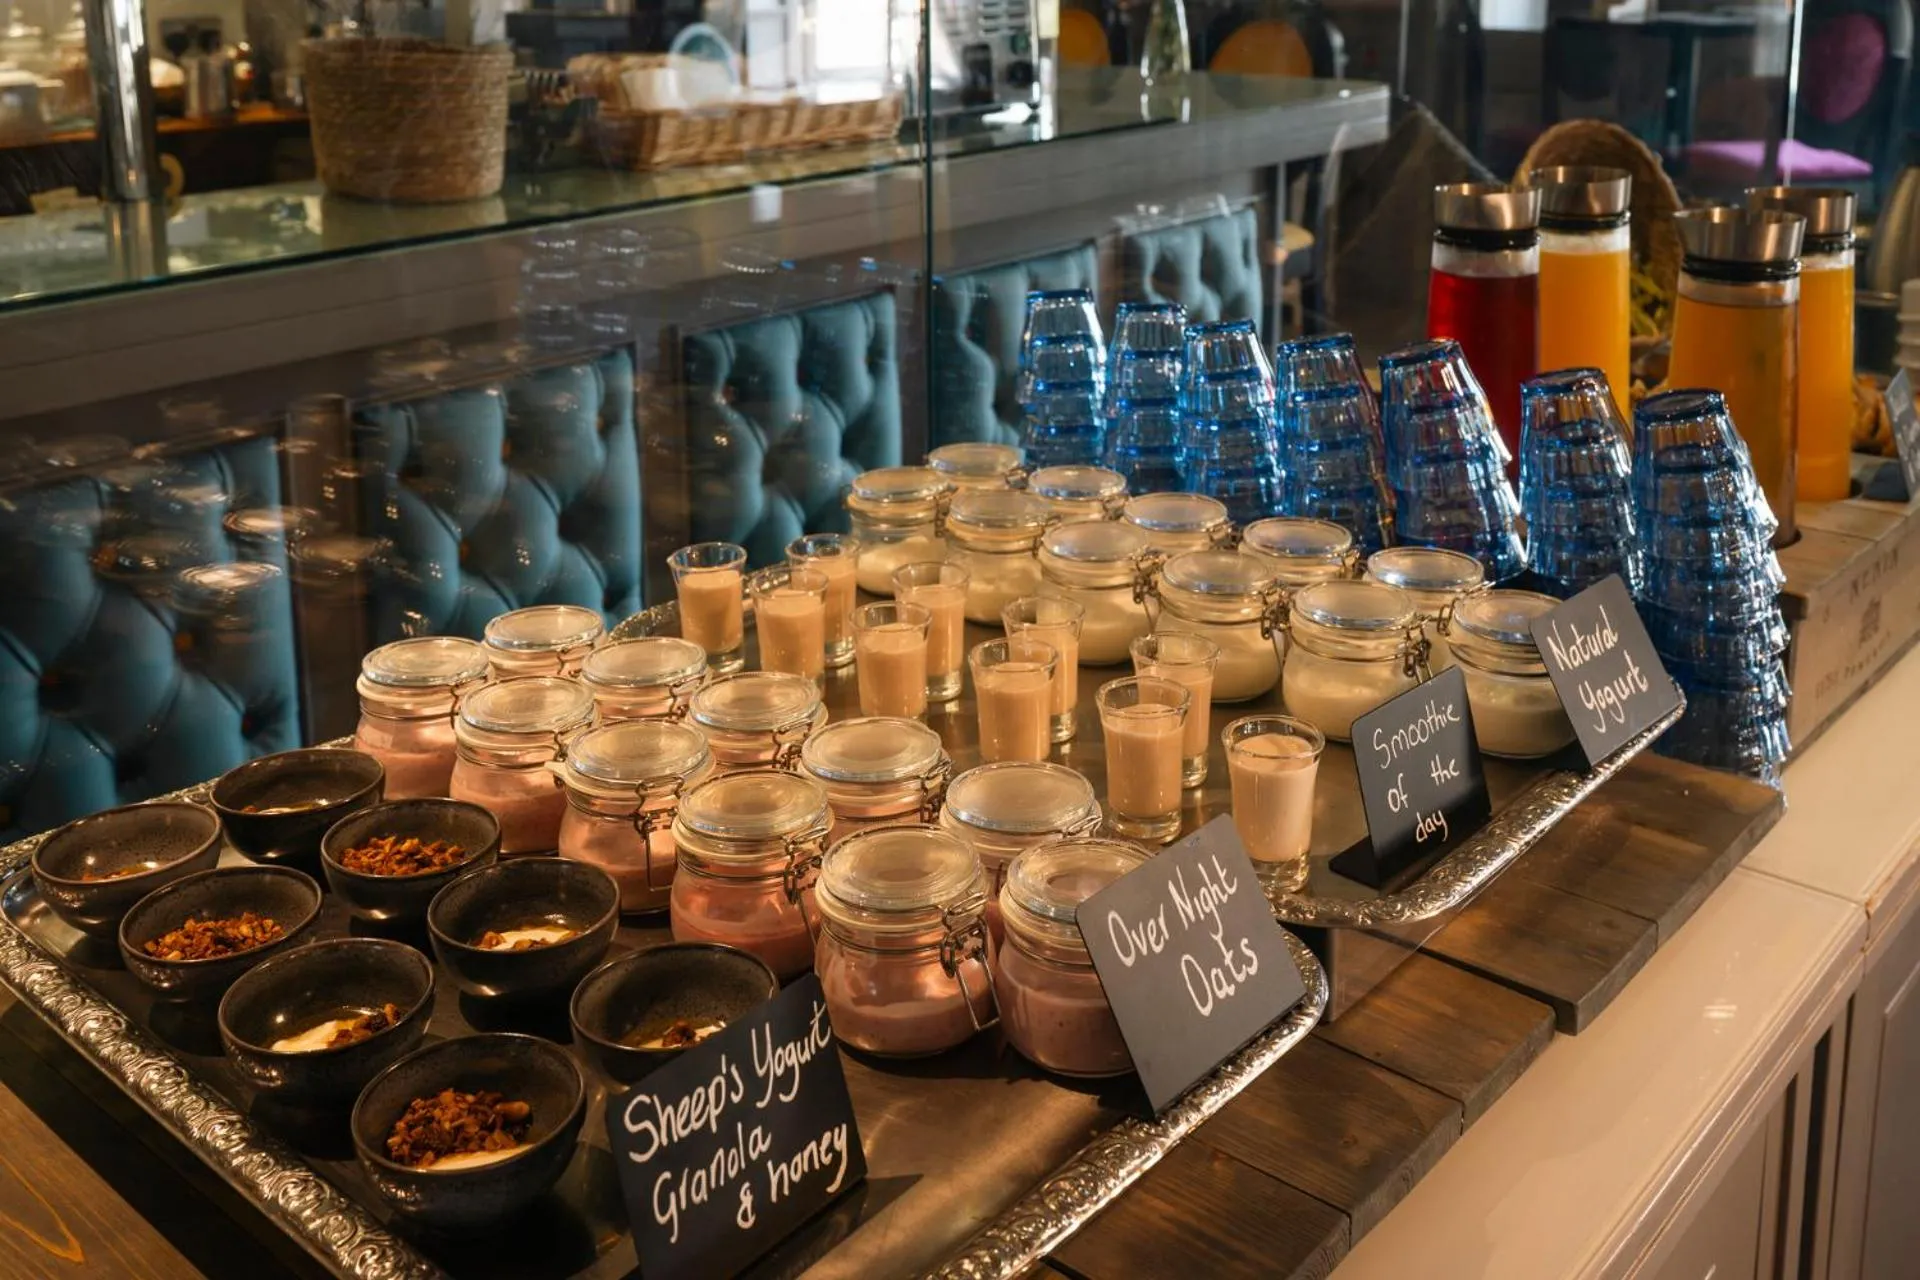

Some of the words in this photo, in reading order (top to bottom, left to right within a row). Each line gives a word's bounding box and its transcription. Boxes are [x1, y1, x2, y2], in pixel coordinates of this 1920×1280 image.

[1547, 604, 1619, 672] Natural
[1373, 700, 1460, 769] Smoothie
[1387, 773, 1409, 812] of
[1430, 754, 1460, 786] the
[1415, 809, 1448, 843] day
[1107, 903, 1170, 967] Over
[1168, 854, 1237, 940] Night
[1180, 934, 1258, 1017] Oats
[623, 1053, 744, 1163] Sheep's
[751, 1000, 831, 1108] Yogurt
[653, 1121, 771, 1244] Granola
[736, 1181, 756, 1229] &
[767, 1123, 848, 1203] honey
